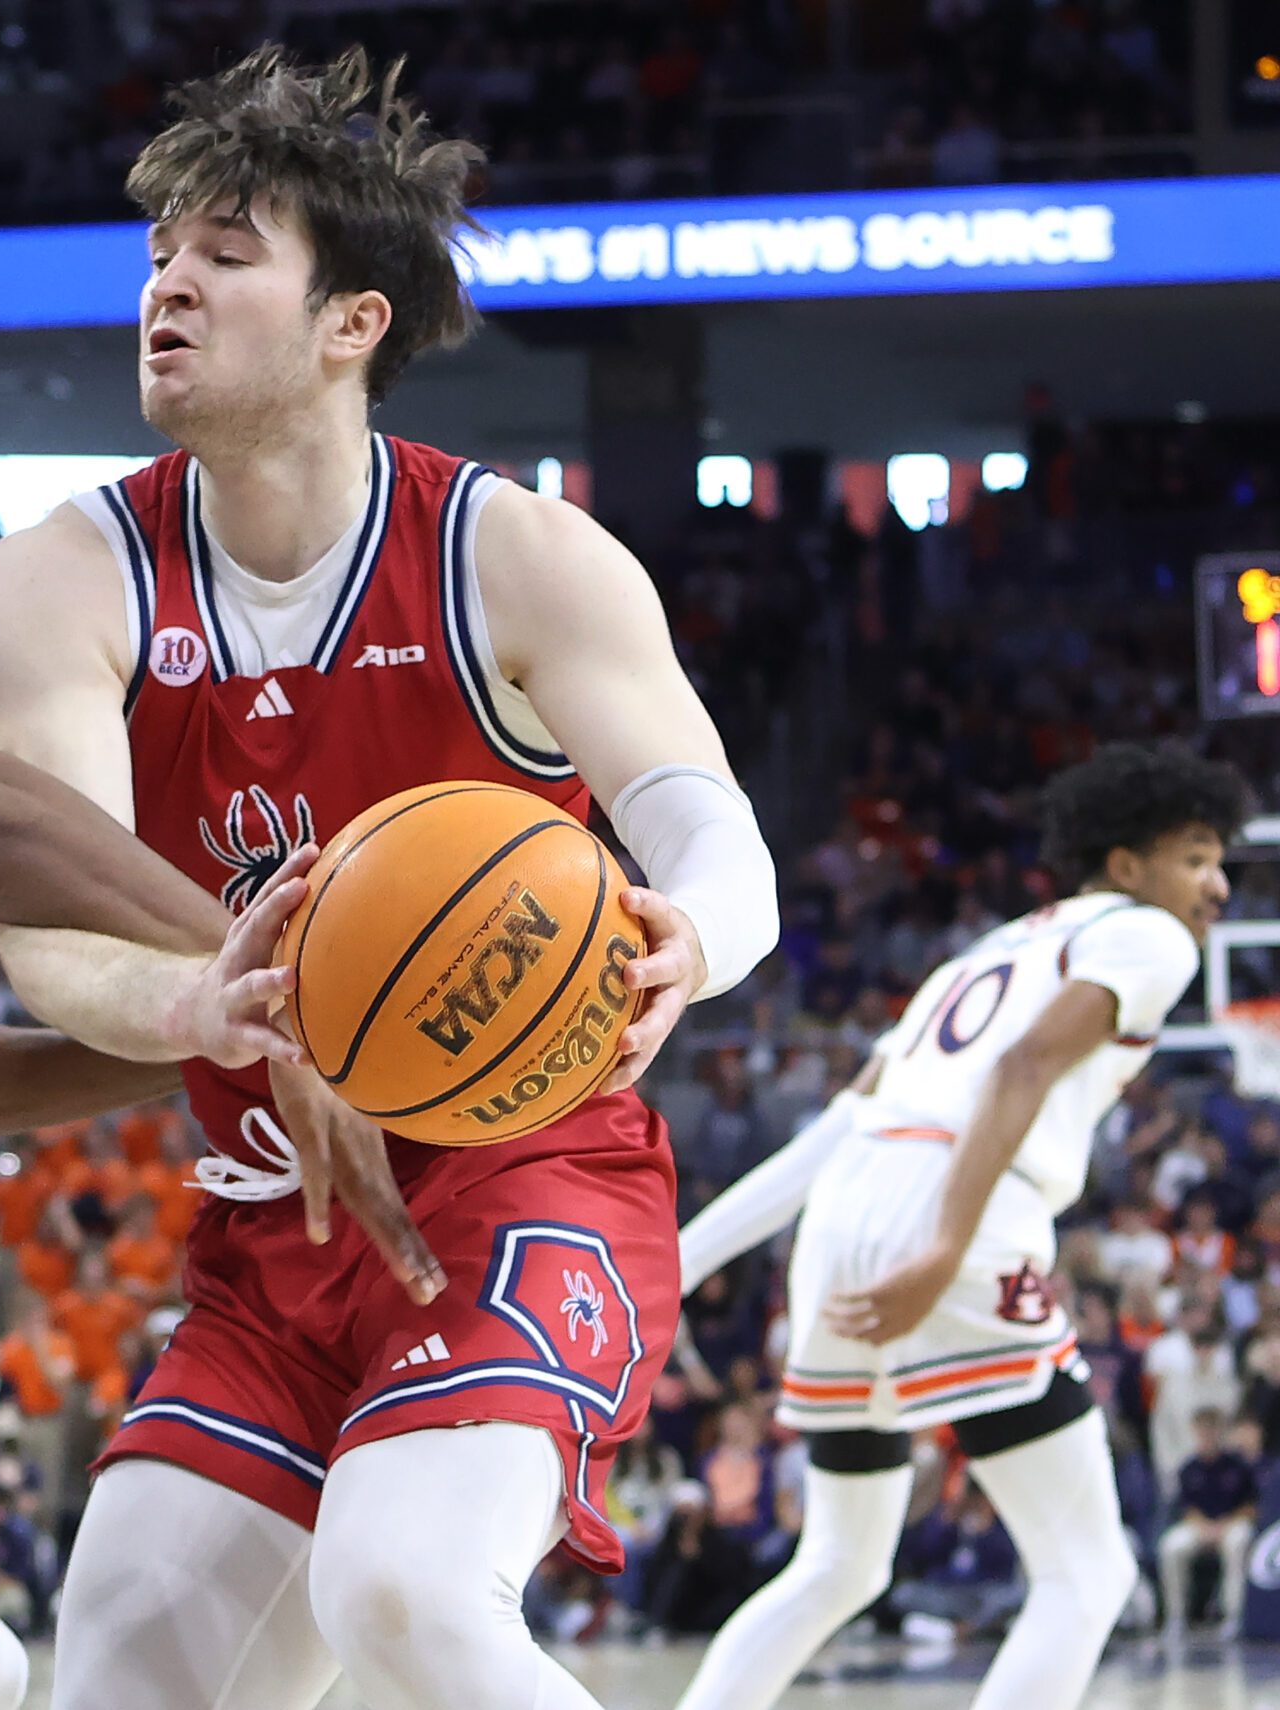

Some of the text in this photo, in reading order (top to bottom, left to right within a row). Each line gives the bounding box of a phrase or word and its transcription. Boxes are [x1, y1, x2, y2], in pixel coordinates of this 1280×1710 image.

[599, 224, 670, 282] #1
[674, 215, 858, 278] NEWS
[862, 205, 1115, 271] SOURCE
[160, 636, 196, 665] 10
[352, 644, 426, 669] A10
[416, 888, 562, 1058] NCAA
[404, 986, 438, 1019] BALL
[905, 963, 1015, 1055] 10
